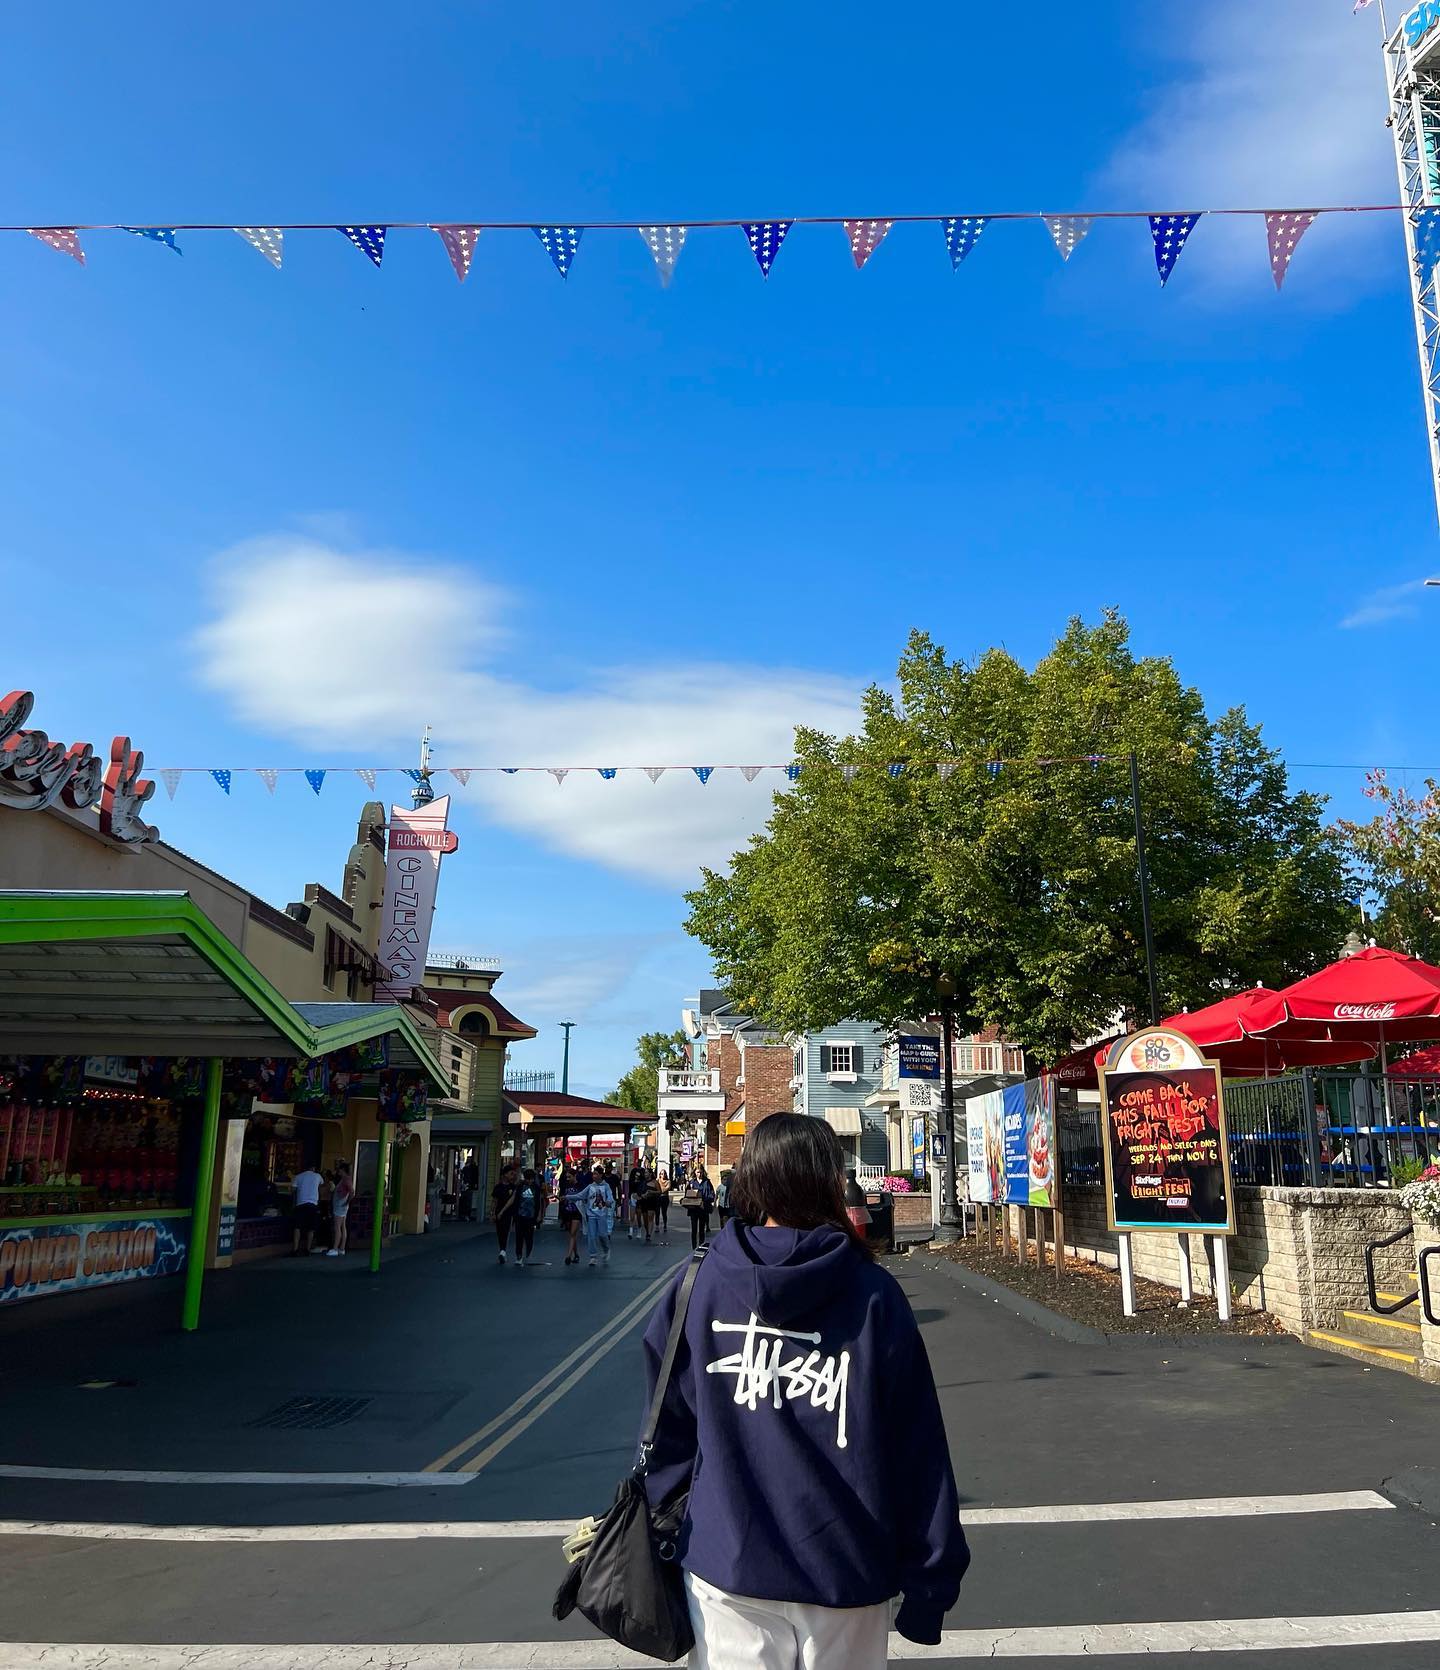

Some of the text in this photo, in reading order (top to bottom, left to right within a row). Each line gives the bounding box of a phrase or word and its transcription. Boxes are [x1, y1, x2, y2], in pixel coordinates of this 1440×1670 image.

[396, 833, 449, 848] ROCKVILLE
[387, 857, 422, 980] CINEMAS
[1333, 1002, 1397, 1019] Coca-Cola
[904, 1043, 921, 1051] TAKE
[1145, 1038, 1164, 1049] GO
[1145, 1047, 1171, 1063] BIG
[1120, 1081, 1193, 1106] COME BACK
[1111, 1097, 1208, 1127] THIS FALL FOR
[1118, 1115, 1206, 1146] FRIGHT FEST!
[1128, 1139, 1217, 1153] WEEKENDS AND SELECT DAYS
[1130, 1155, 1145, 1165] SEP
[1148, 1153, 1163, 1164] 24
[1187, 1150, 1205, 1162] NOV
[1209, 1149, 1218, 1160] 6
[1133, 1183, 1189, 1196] FRIGHT FEST
[0, 1229, 157, 1289] POWER STATION
